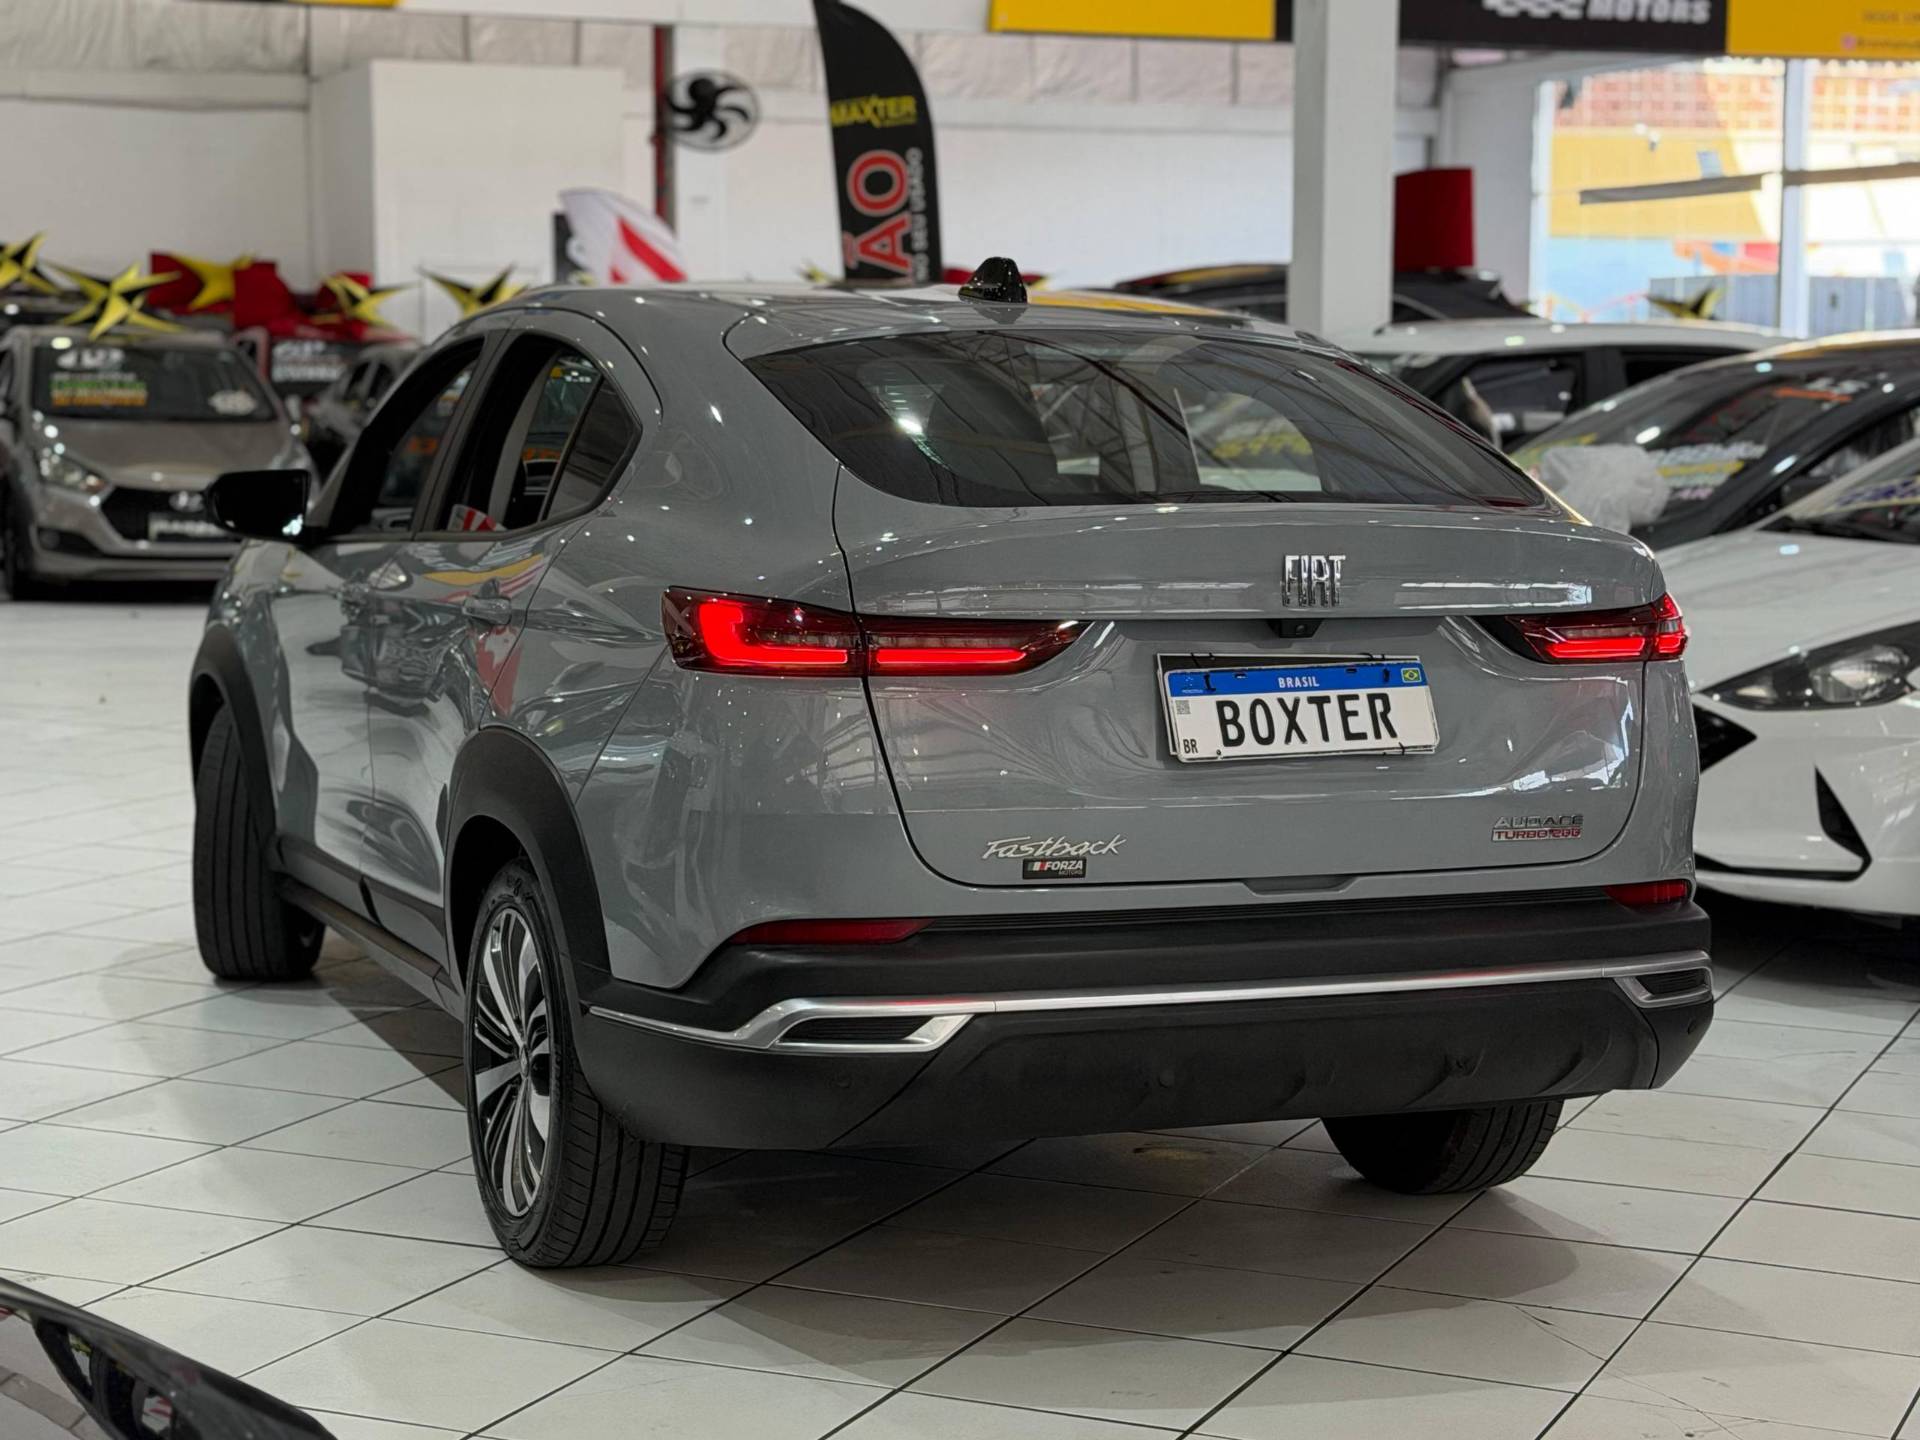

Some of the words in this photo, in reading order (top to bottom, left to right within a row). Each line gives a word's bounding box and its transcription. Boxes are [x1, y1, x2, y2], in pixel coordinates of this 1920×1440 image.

[1587, 0, 1711, 23] MOTORS
[830, 95, 917, 128] MAXTER
[905, 148, 926, 212] USADO
[1283, 555, 1346, 606] FIAT
[1278, 676, 1320, 688] BRASIL
[1215, 693, 1397, 747] BOXTER
[1183, 738, 1199, 754] BR
[1493, 815, 1583, 828] AUDACE
[1495, 830, 1548, 839] TURBO
[1550, 829, 1581, 838] 200
[981, 834, 1126, 859] Fastback
[1044, 860, 1083, 871] FORZA
